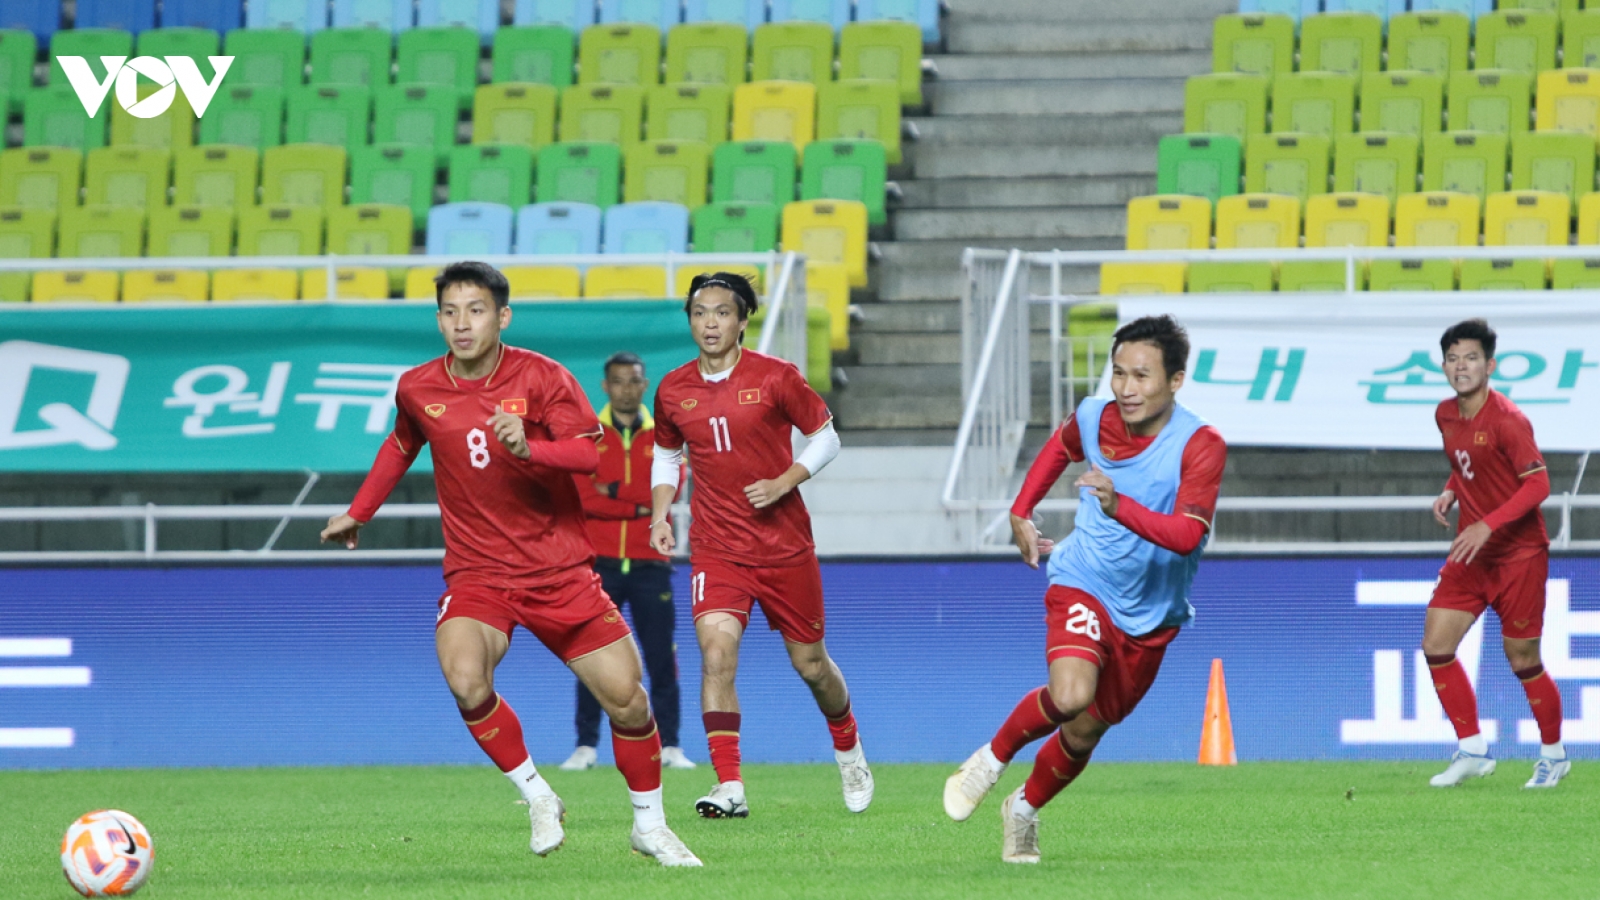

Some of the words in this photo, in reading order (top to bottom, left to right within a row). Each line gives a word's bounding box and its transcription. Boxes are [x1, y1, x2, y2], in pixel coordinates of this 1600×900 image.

[1192, 347, 1306, 401] 내
[466, 427, 491, 469] 8
[708, 416, 732, 452] 11
[1455, 449, 1475, 480] 12
[692, 571, 706, 606] 11
[1065, 602, 1101, 641] 26
